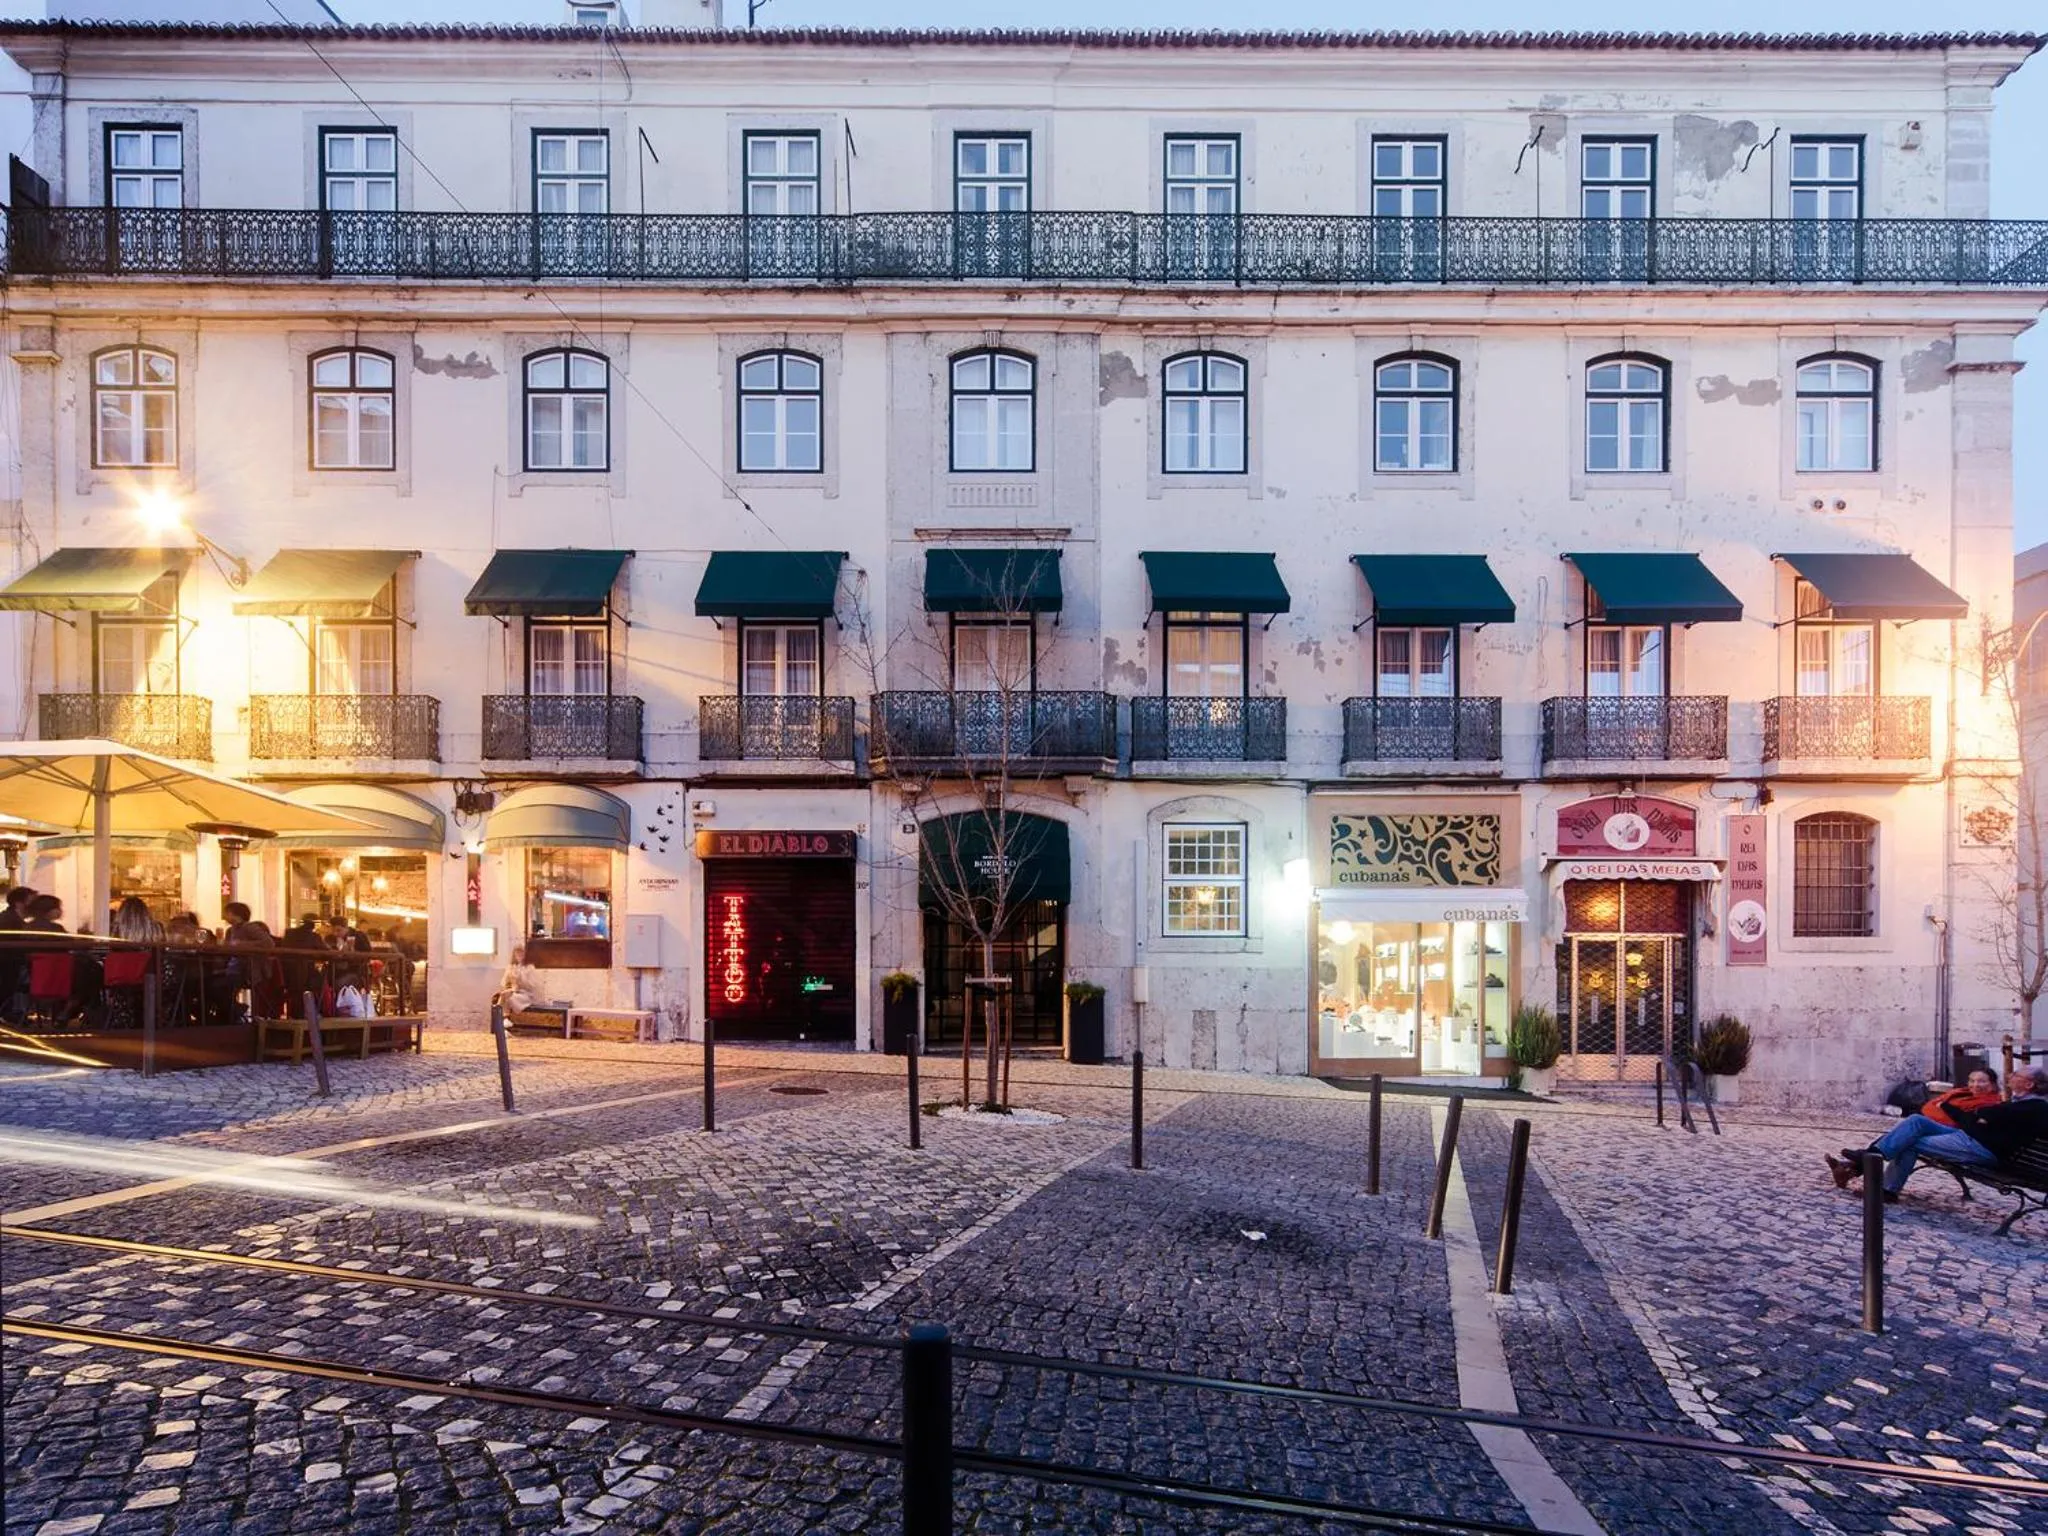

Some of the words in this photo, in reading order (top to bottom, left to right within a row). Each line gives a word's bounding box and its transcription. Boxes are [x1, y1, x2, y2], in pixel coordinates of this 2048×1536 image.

[1580, 809, 1602, 833] REI
[1613, 799, 1639, 814] DAS
[1647, 807, 1683, 844] MEIAS
[1743, 824, 1751, 834] O
[720, 836, 744, 852] EL
[751, 835, 829, 853] DIABLO
[1740, 843, 1756, 853] REI
[974, 860, 1017, 868] BORDLO
[1737, 861, 1758, 872] DAS
[1571, 865, 1582, 875] O
[1587, 865, 1611, 875] REI
[1616, 865, 1648, 874] DAS
[1652, 865, 1701, 875] MEIAS
[723, 896, 744, 1002] TATTOO
